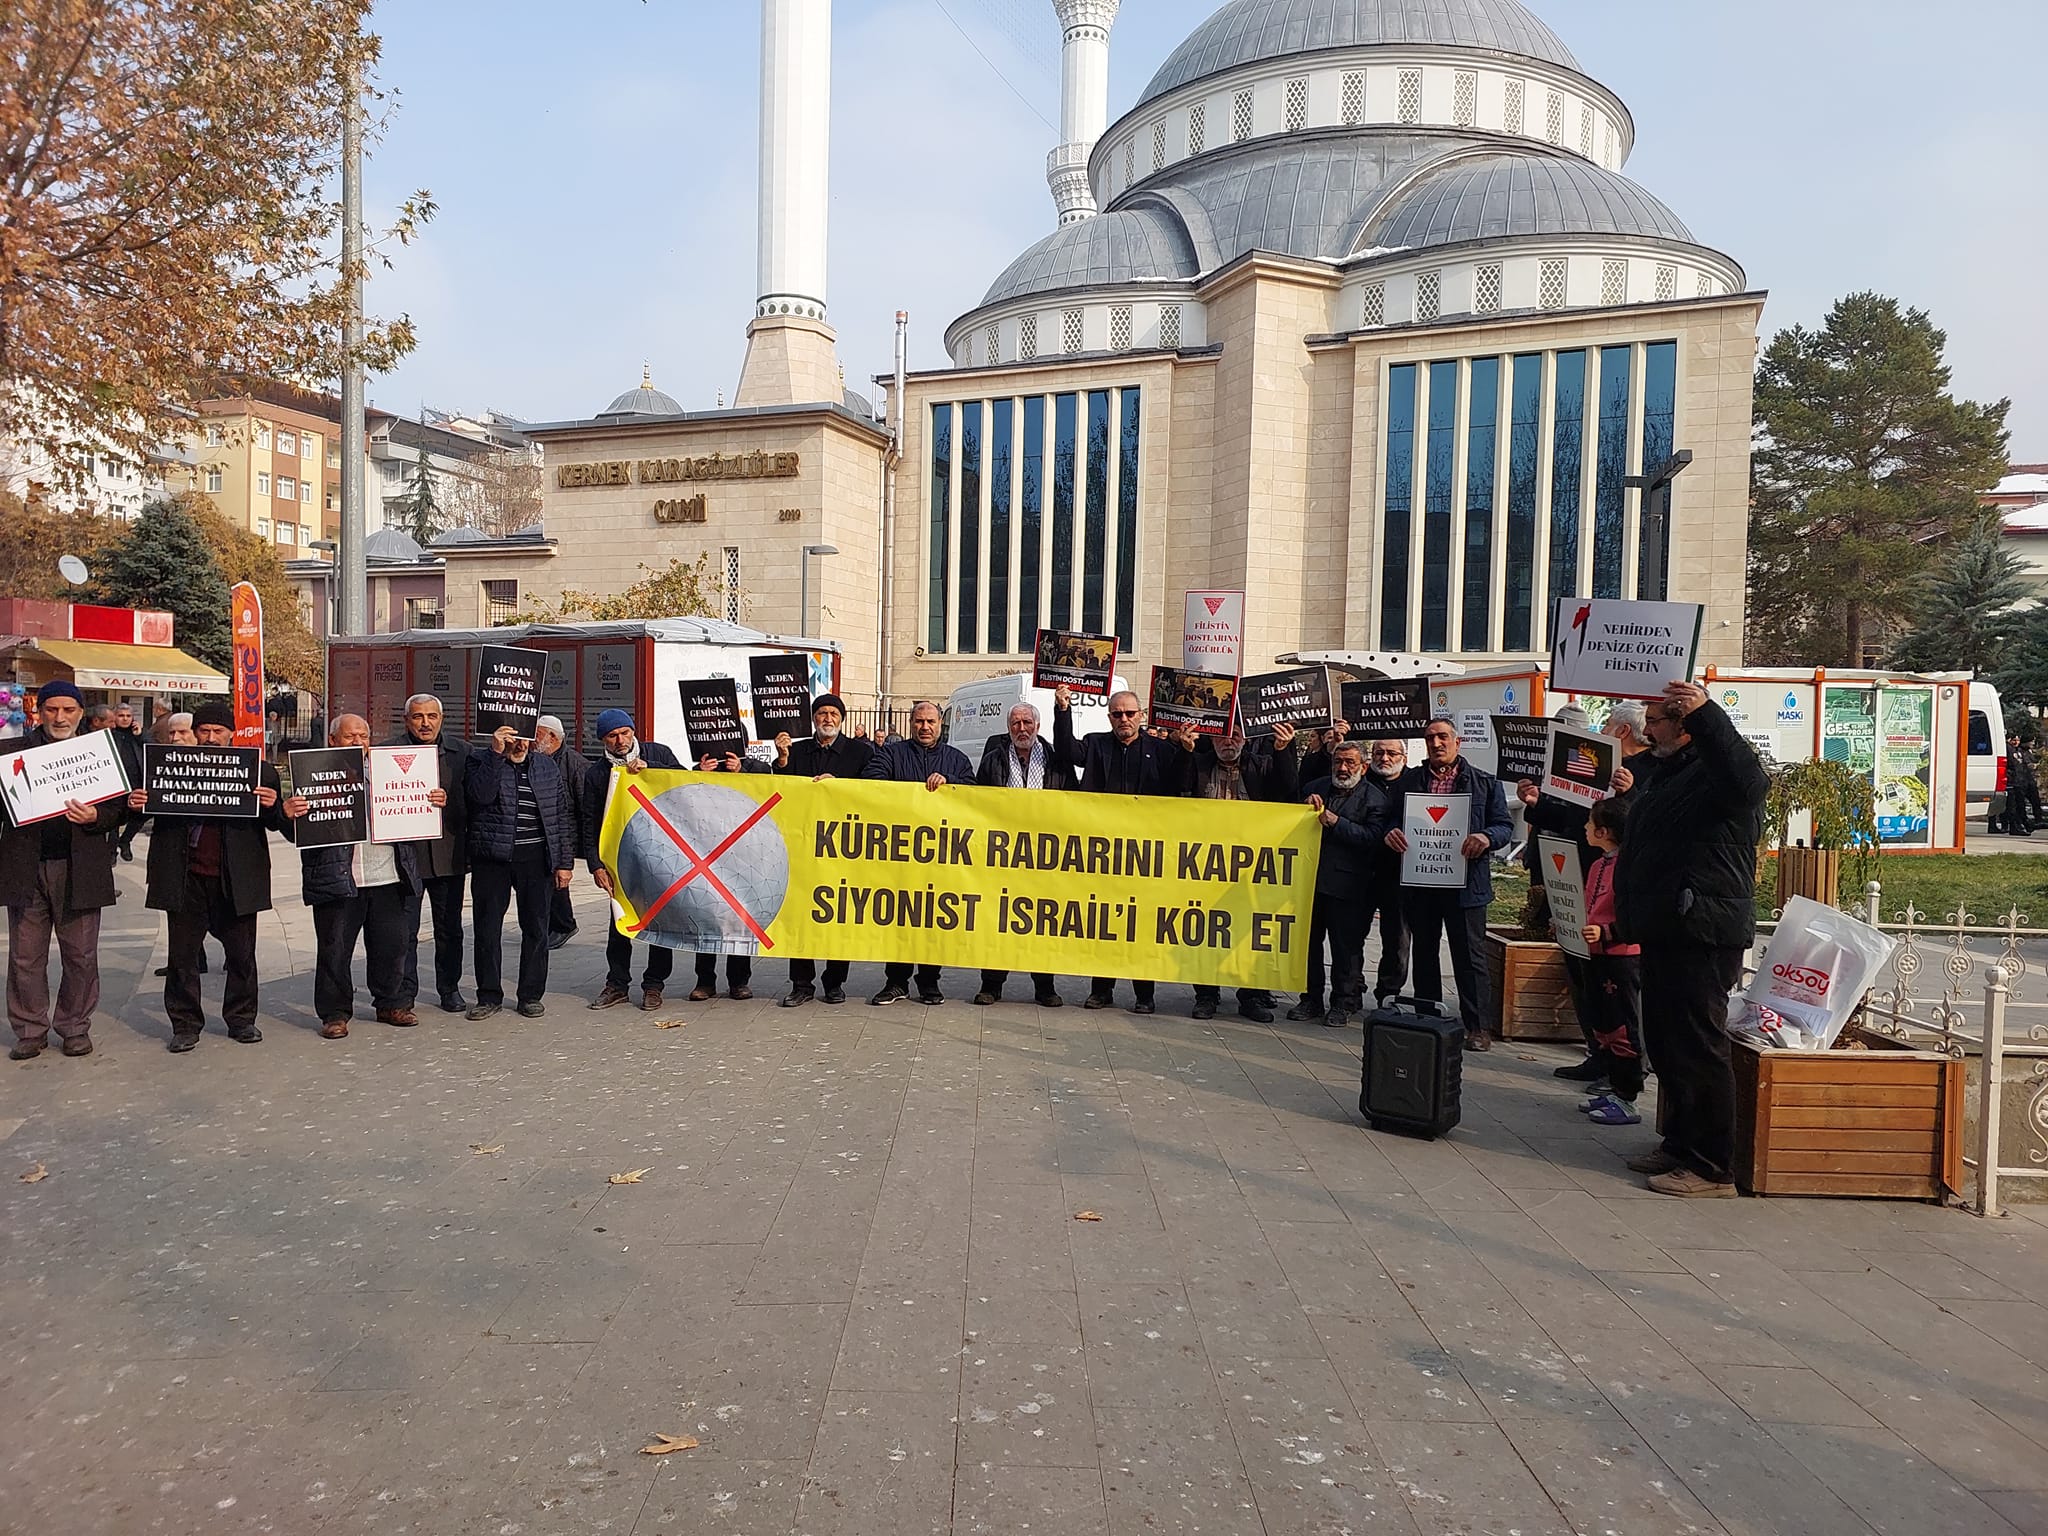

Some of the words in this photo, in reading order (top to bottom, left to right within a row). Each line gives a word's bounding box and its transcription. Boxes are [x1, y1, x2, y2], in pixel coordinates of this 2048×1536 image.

[558, 461, 632, 488] KERNEK
[637, 448, 800, 483] KARAGÖZLÜLER
[654, 494, 708, 523] CAMİİ
[778, 509, 801, 521] 2019
[1194, 620, 1230, 630] FİLİSTİN
[1603, 622, 1673, 639] NEHİRDEN
[1186, 634, 1238, 642] DOSTLARINA
[1188, 644, 1233, 654] ÖZGÜRLÜK
[1587, 638, 1634, 654] DENİZE
[1636, 639, 1684, 658] ÖZGÜR
[493, 663, 532, 676] VİCDAN
[1604, 657, 1660, 674] FİLİSTİN
[100, 676, 158, 690] YALÇIN
[168, 679, 208, 690] BÜFE
[486, 676, 534, 690] GEMİSİNE
[765, 674, 794, 682] NEDEN
[1062, 676, 1104, 688] DOSTLARINI
[752, 685, 810, 696] AZERBAYCAN
[1260, 681, 1306, 697] FİLİSTİN
[481, 689, 512, 701] NEDEN
[514, 690, 536, 703] İZİN
[692, 696, 726, 705] VİCDAN
[761, 696, 800, 706] PETROLÜ
[1362, 690, 1406, 704] FİLİSTİN
[478, 700, 538, 716] VERİLMİYOR
[980, 700, 1002, 717] belsos
[1261, 696, 1310, 711] DAVAMIZ
[690, 707, 732, 718] GEMİSİNE
[764, 708, 800, 719] GİDİYOR
[1246, 708, 1328, 727] YARGILANAMAZ
[1361, 706, 1410, 717] DAVAMIZ
[1777, 710, 1804, 720] MASKİ
[688, 720, 717, 730] NEDEN
[718, 718, 736, 728] İZİN
[1180, 716, 1224, 728] DOSTLARINI
[1351, 720, 1428, 731] ARGILANAMAZ
[1504, 722, 1548, 735] SİYONİSTLE
[688, 730, 742, 742] VERİLMİYOR
[41, 750, 96, 772] NEHİRDEN
[166, 751, 240, 765] SİYONİSTLER
[34, 770, 74, 787] DENİZE
[75, 759, 111, 778] ÖZGÜR
[156, 765, 248, 778] FAALİYETLERİNİ
[312, 770, 346, 782] NEDEN
[55, 775, 100, 795] FİLİSTİN
[152, 778, 251, 792] LİMANLARIMIZDA
[295, 780, 364, 797] AZERBAYCAN
[385, 779, 426, 790] FİLİSTİN
[1550, 776, 1570, 791] DOWN
[1572, 782, 1590, 798] WITH
[162, 792, 240, 806] SÜRDÜRÜYOR
[307, 794, 354, 808] PETROLÜ
[308, 808, 353, 822] GİDİYOR
[380, 805, 433, 816] ÖZGÜRLÜK
[1413, 828, 1460, 837] NEHİRDEN
[815, 814, 974, 867] KÜRECİK
[986, 830, 1164, 878] RADARINI
[1177, 842, 1298, 886] KAPAT
[1420, 839, 1453, 850] DENİZE
[1419, 852, 1452, 862] ÖZGÜR
[1415, 864, 1454, 874] FİLİSTİN
[812, 878, 981, 932] SİYONİST
[1156, 900, 1232, 949] KÖR
[1252, 912, 1296, 954] ET
[1772, 964, 1830, 996] aksoy
